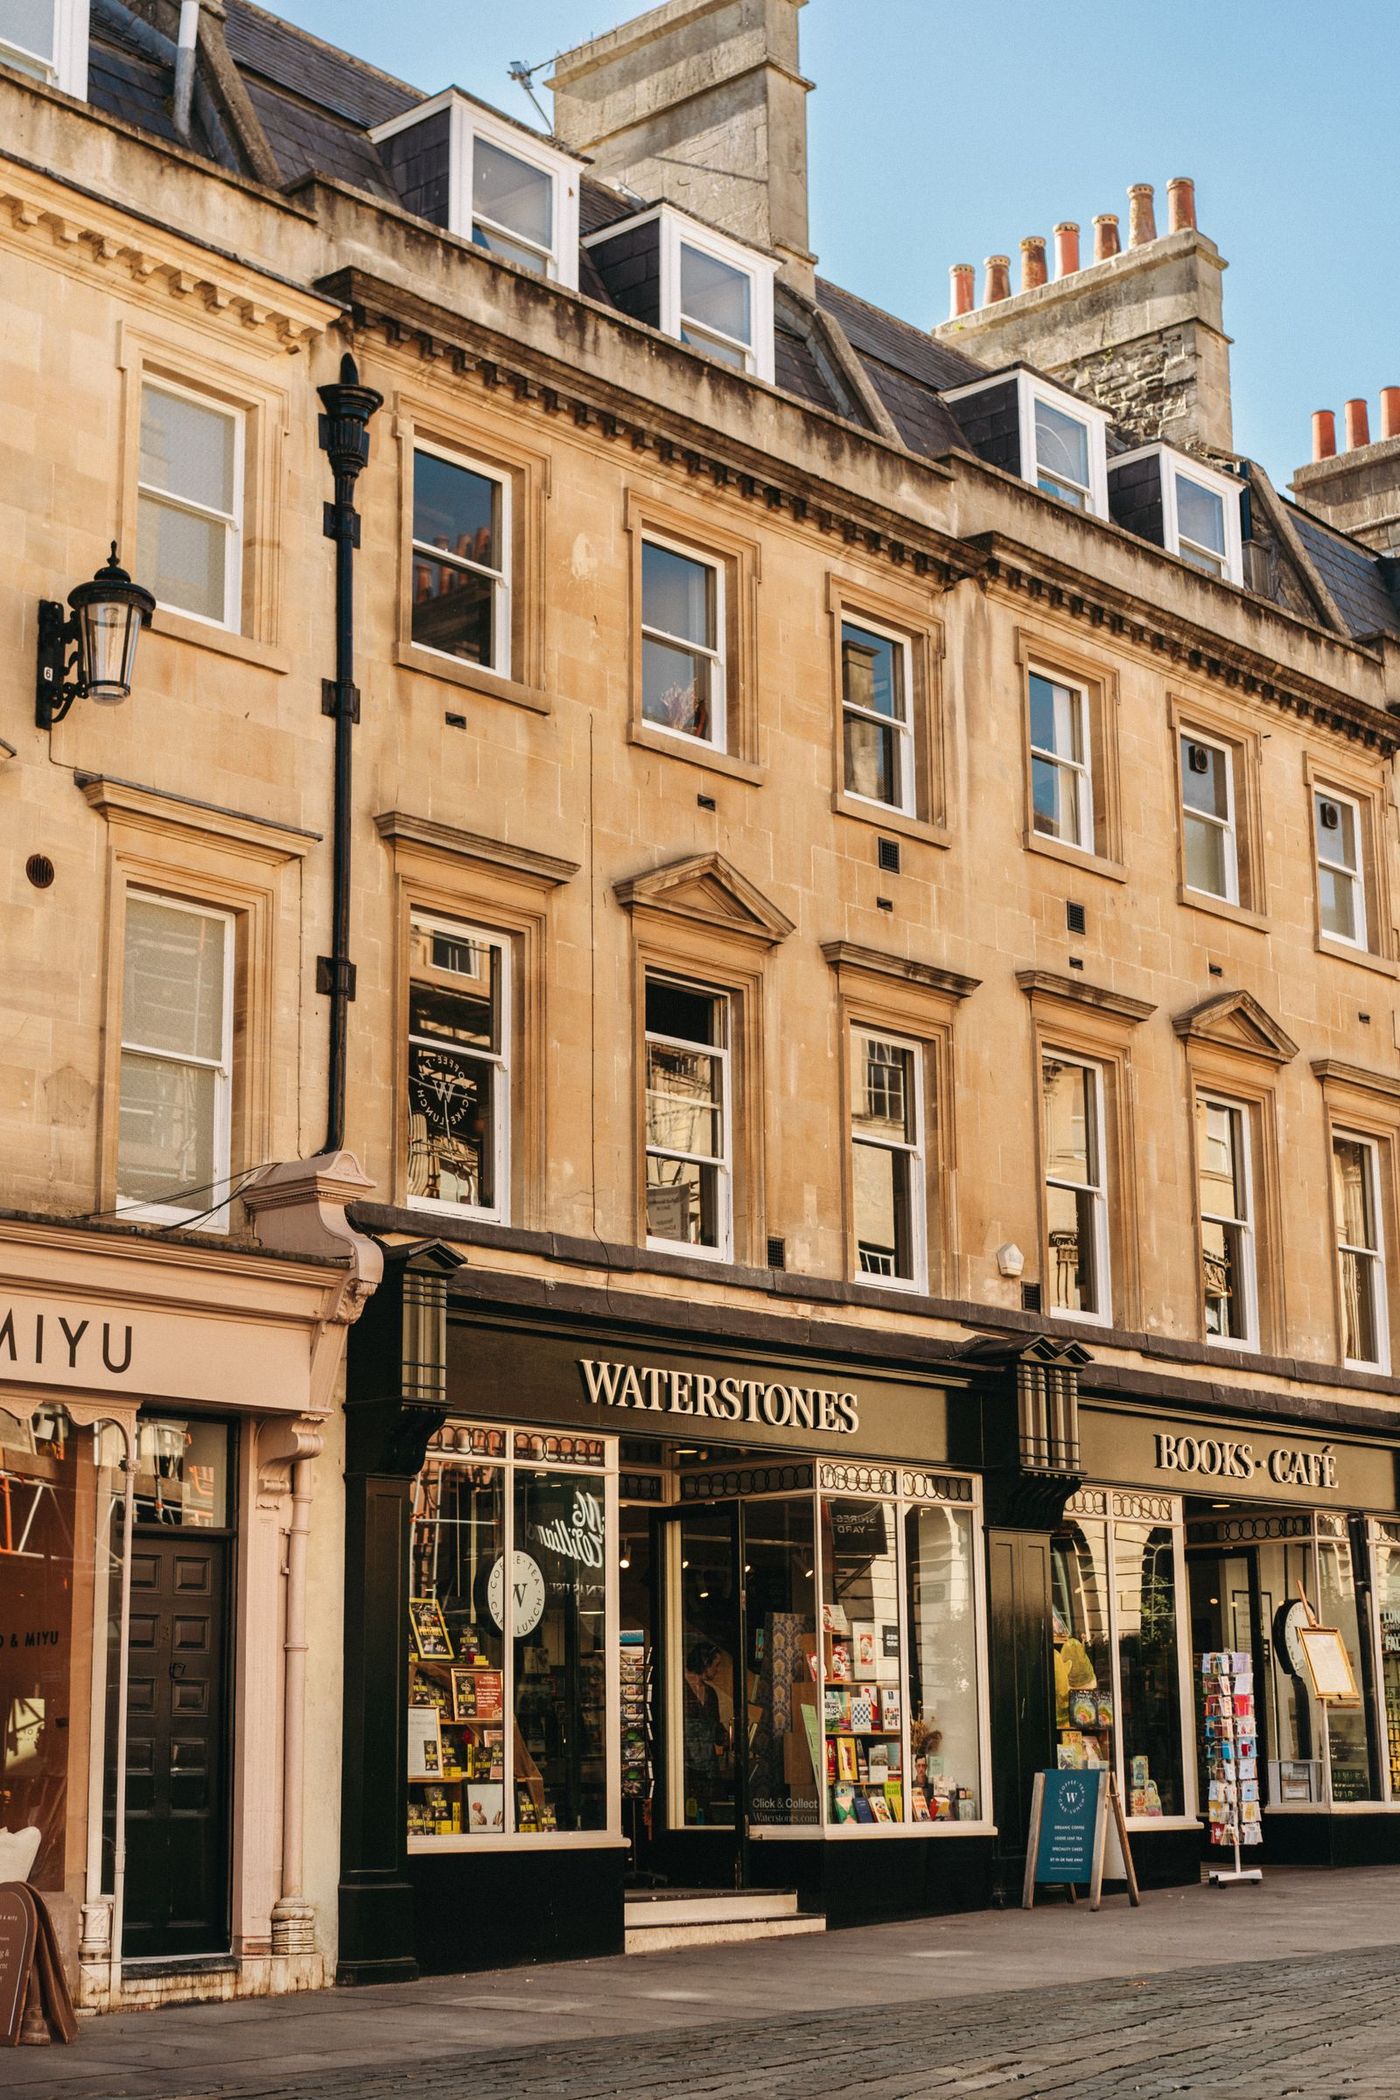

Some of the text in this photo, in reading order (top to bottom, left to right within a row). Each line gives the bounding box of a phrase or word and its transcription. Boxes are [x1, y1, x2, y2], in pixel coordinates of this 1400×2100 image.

[579, 1359, 860, 1434] WATERSTONES
[1157, 1434, 1339, 1489] BOOKS CAFÉ
[527, 1562, 540, 1586] TEA
[516, 1597, 543, 1635] LUNCH
[10, 1632, 18, 1648] &
[24, 1630, 59, 1648] MIYU
[752, 1797, 818, 1809] Click & Collect
[1066, 1792, 1078, 1803] W
[752, 1811, 818, 1824] Waterstones.com
